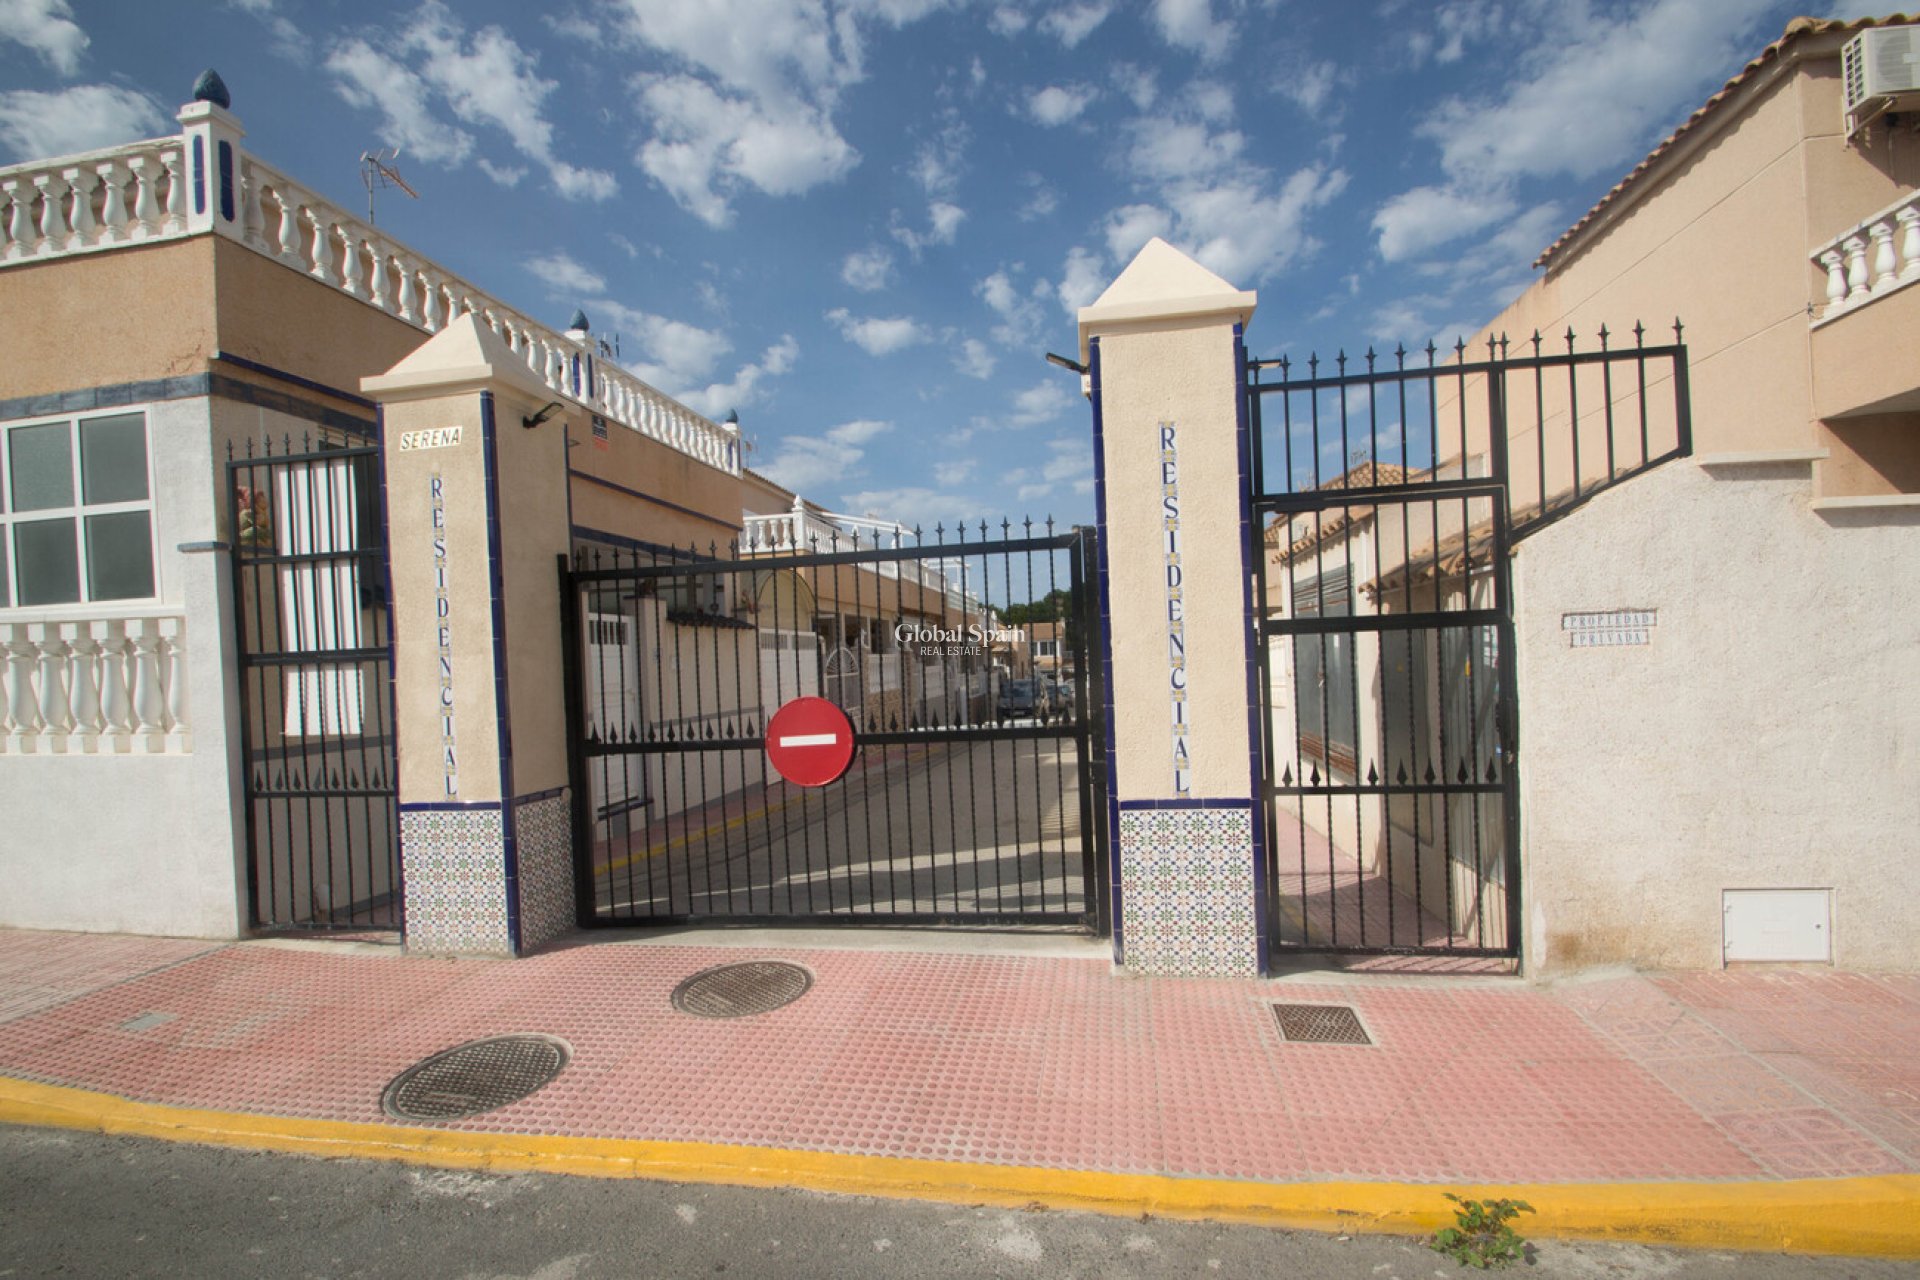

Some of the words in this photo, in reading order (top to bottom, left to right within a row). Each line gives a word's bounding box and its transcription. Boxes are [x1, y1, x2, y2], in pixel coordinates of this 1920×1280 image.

[402, 427, 460, 450] SERENA
[1160, 426, 1190, 792] RESIDENCIAL
[1570, 614, 1649, 627] PROPIEDAD
[432, 478, 457, 796] RESIDENCIAL
[1579, 632, 1641, 645] PRIVADA
